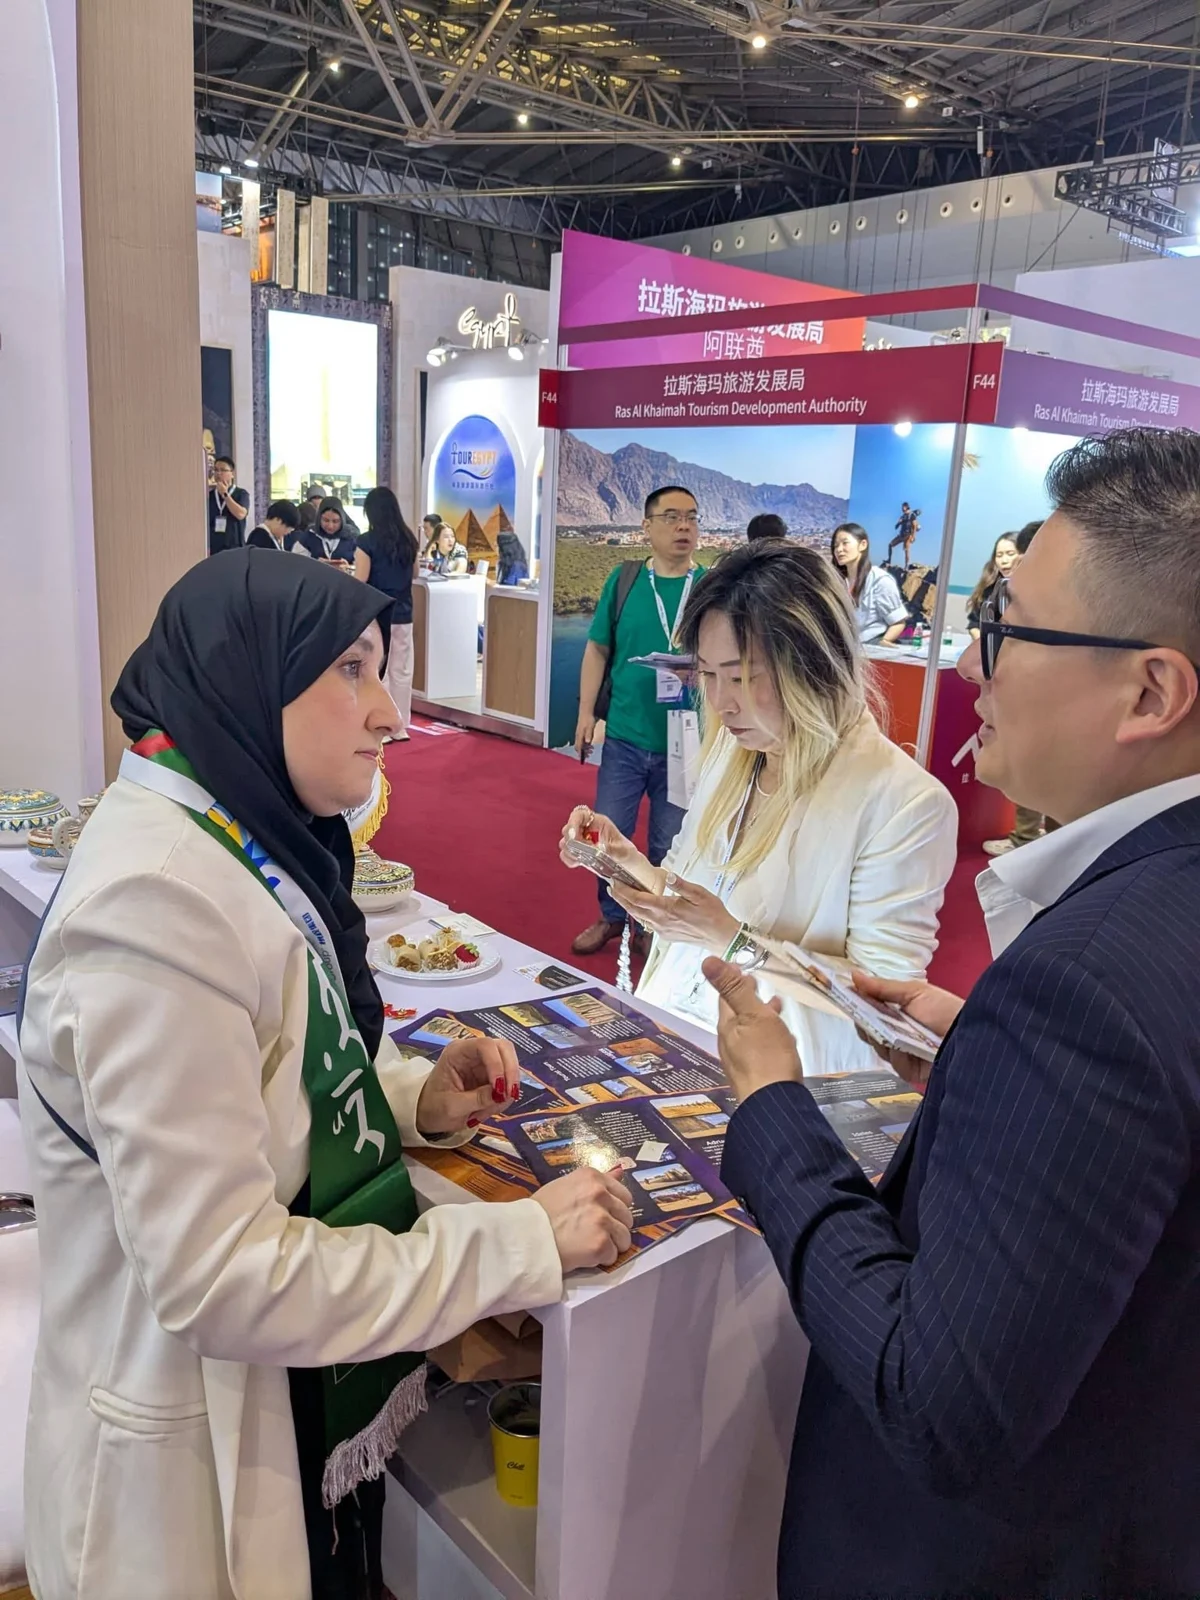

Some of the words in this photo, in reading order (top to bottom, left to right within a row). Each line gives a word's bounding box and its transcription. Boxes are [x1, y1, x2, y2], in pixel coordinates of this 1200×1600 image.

[663, 368, 805, 397] 拉斯海玛旅游发展局
[973, 374, 996, 390] F44
[615, 405, 631, 418] Ras
[632, 404, 642, 418] Al
[643, 403, 686, 417] Khaimah
[688, 401, 729, 416] Tourism
[731, 398, 807, 416] Development
[809, 396, 867, 416] Authority
[1081, 378, 1180, 417] 拉斯海玛旅游发展局
[1034, 404, 1050, 419] Ras
[1051, 406, 1061, 421] Al
[1061, 408, 1098, 426] Khaimah
[1100, 412, 1130, 429] Tourism
